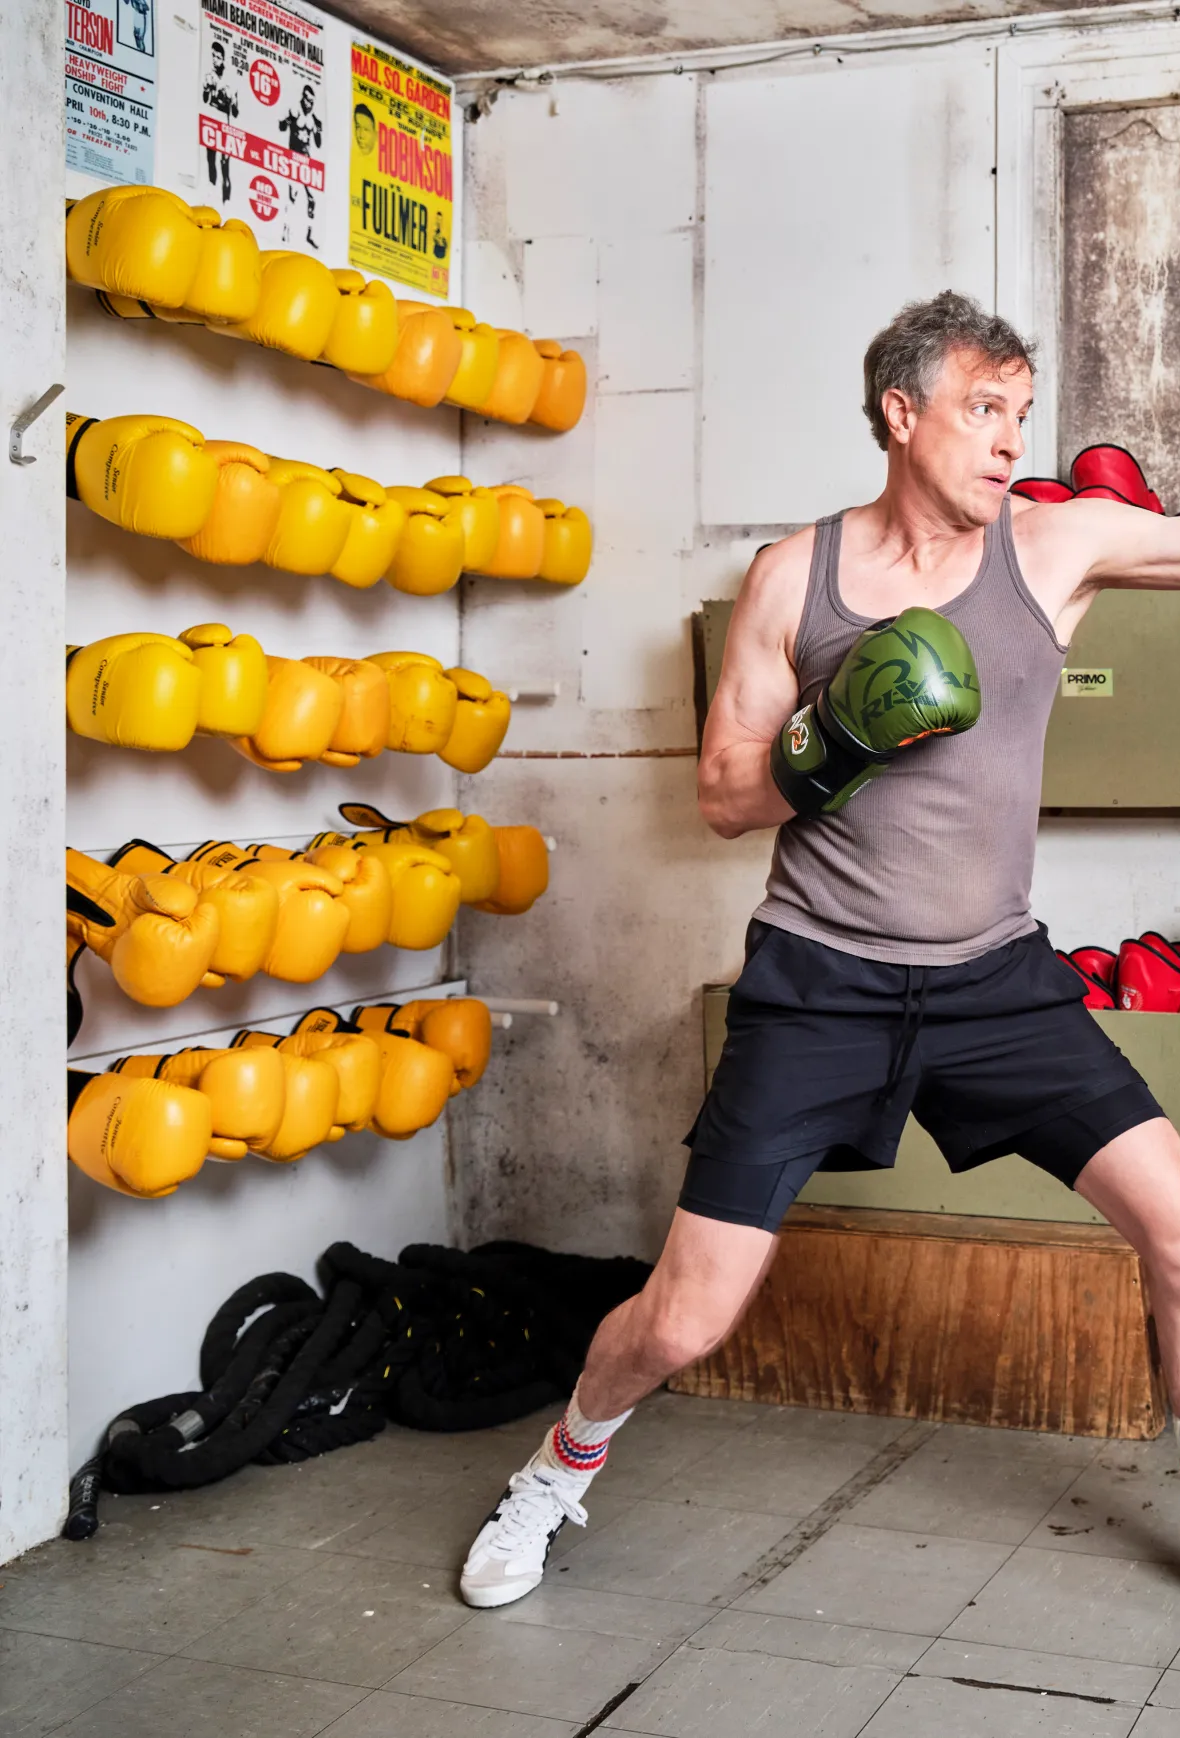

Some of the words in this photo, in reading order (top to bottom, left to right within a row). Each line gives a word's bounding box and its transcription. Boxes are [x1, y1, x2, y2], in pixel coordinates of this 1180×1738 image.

[230, 4, 257, 34] BEACH
[258, 18, 306, 57] CONVENTION
[307, 43, 324, 66] HALL
[69, 54, 128, 85] HEAVYWEIGHT
[101, 78, 124, 94] FIGHT
[352, 48, 382, 86] MAD.
[384, 66, 405, 98] SQ.
[406, 77, 450, 122] GARDEN
[73, 83, 125, 110] CONVENTION
[130, 105, 149, 120] HALL
[112, 115, 130, 129] 8:30
[202, 125, 247, 159] CLAY
[263, 149, 323, 189] LISTON
[378, 122, 453, 203] ROBINSON
[256, 202, 272, 217] TV
[363, 179, 427, 254] FULLMER
[94, 220, 104, 247] Senior
[112, 467, 120, 494] Senior
[100, 680, 109, 707] Senior
[1067, 674, 1106, 684] PRIMO
